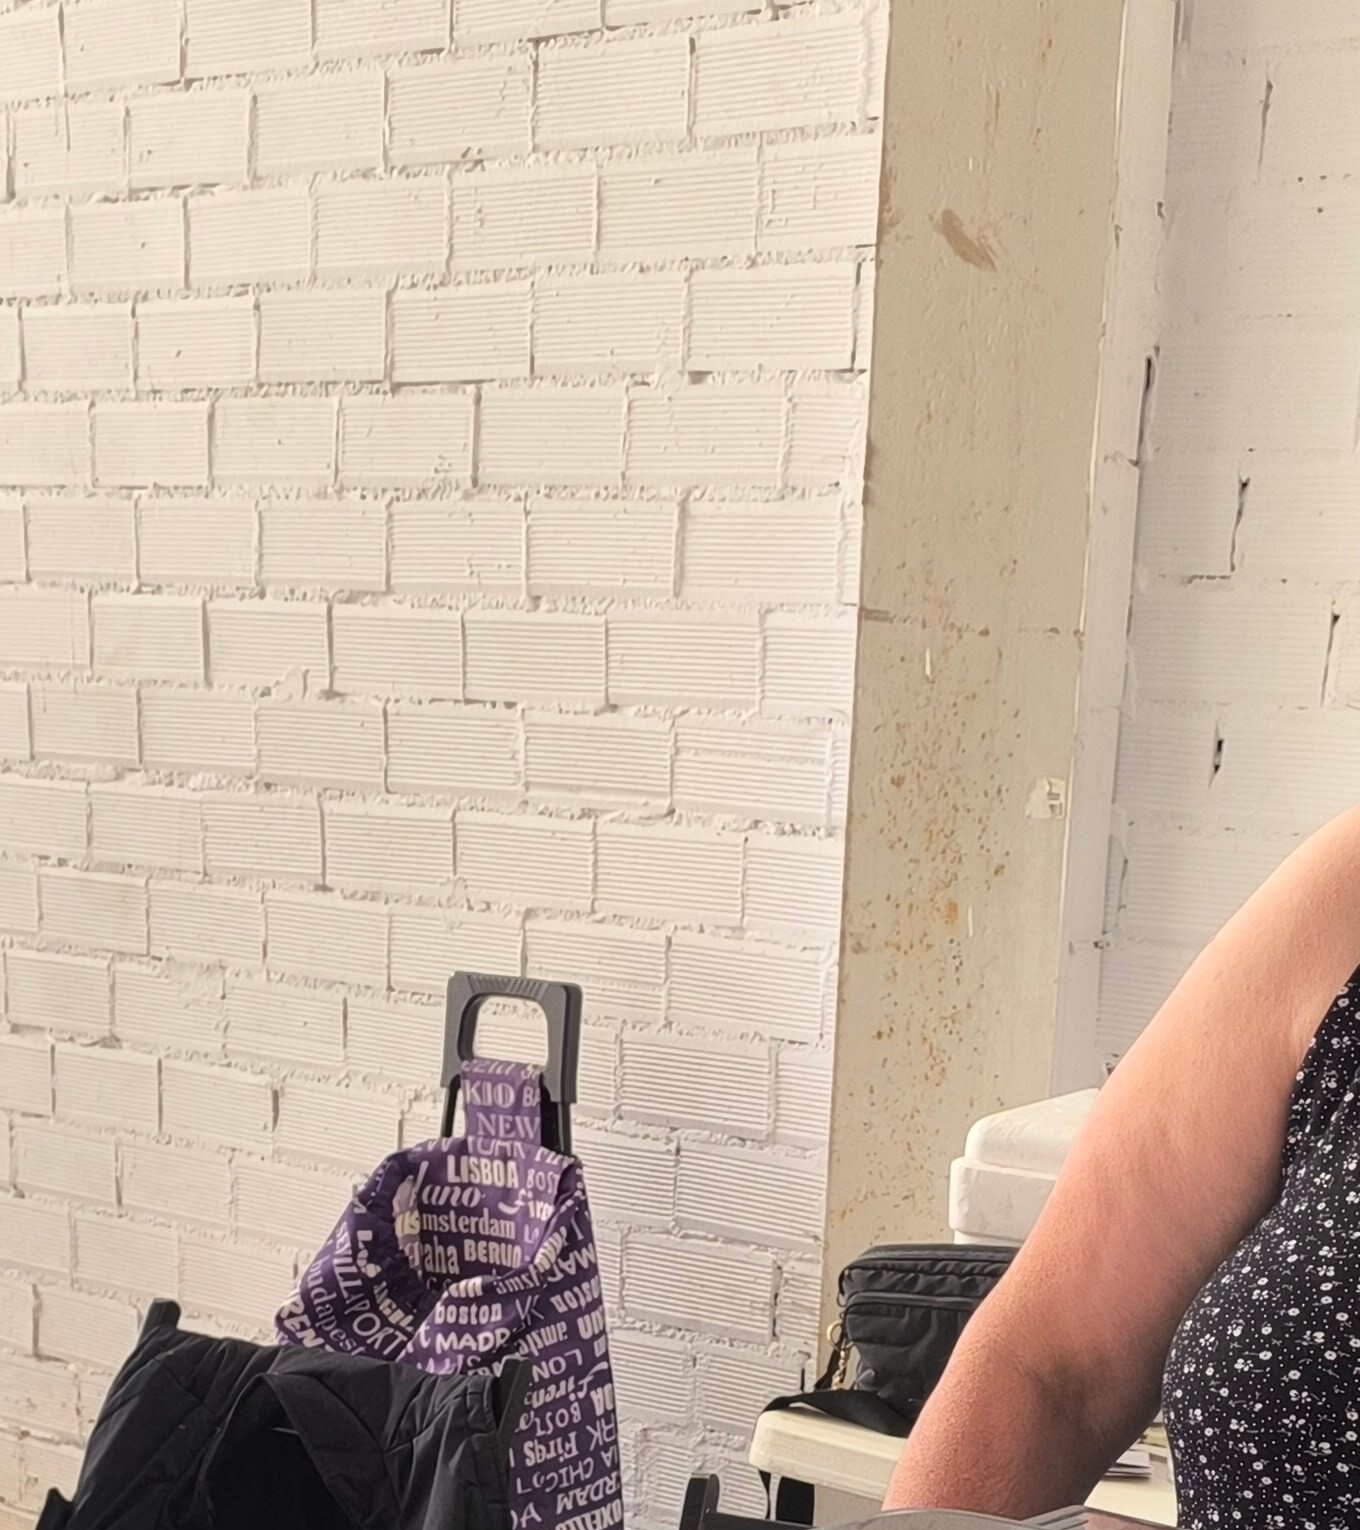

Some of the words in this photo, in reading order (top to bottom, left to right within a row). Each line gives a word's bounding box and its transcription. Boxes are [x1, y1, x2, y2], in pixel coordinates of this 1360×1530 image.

[476, 1112, 540, 1139] NEW
[447, 1154, 519, 1189] LISBOA
[434, 1302, 503, 1325] boston
